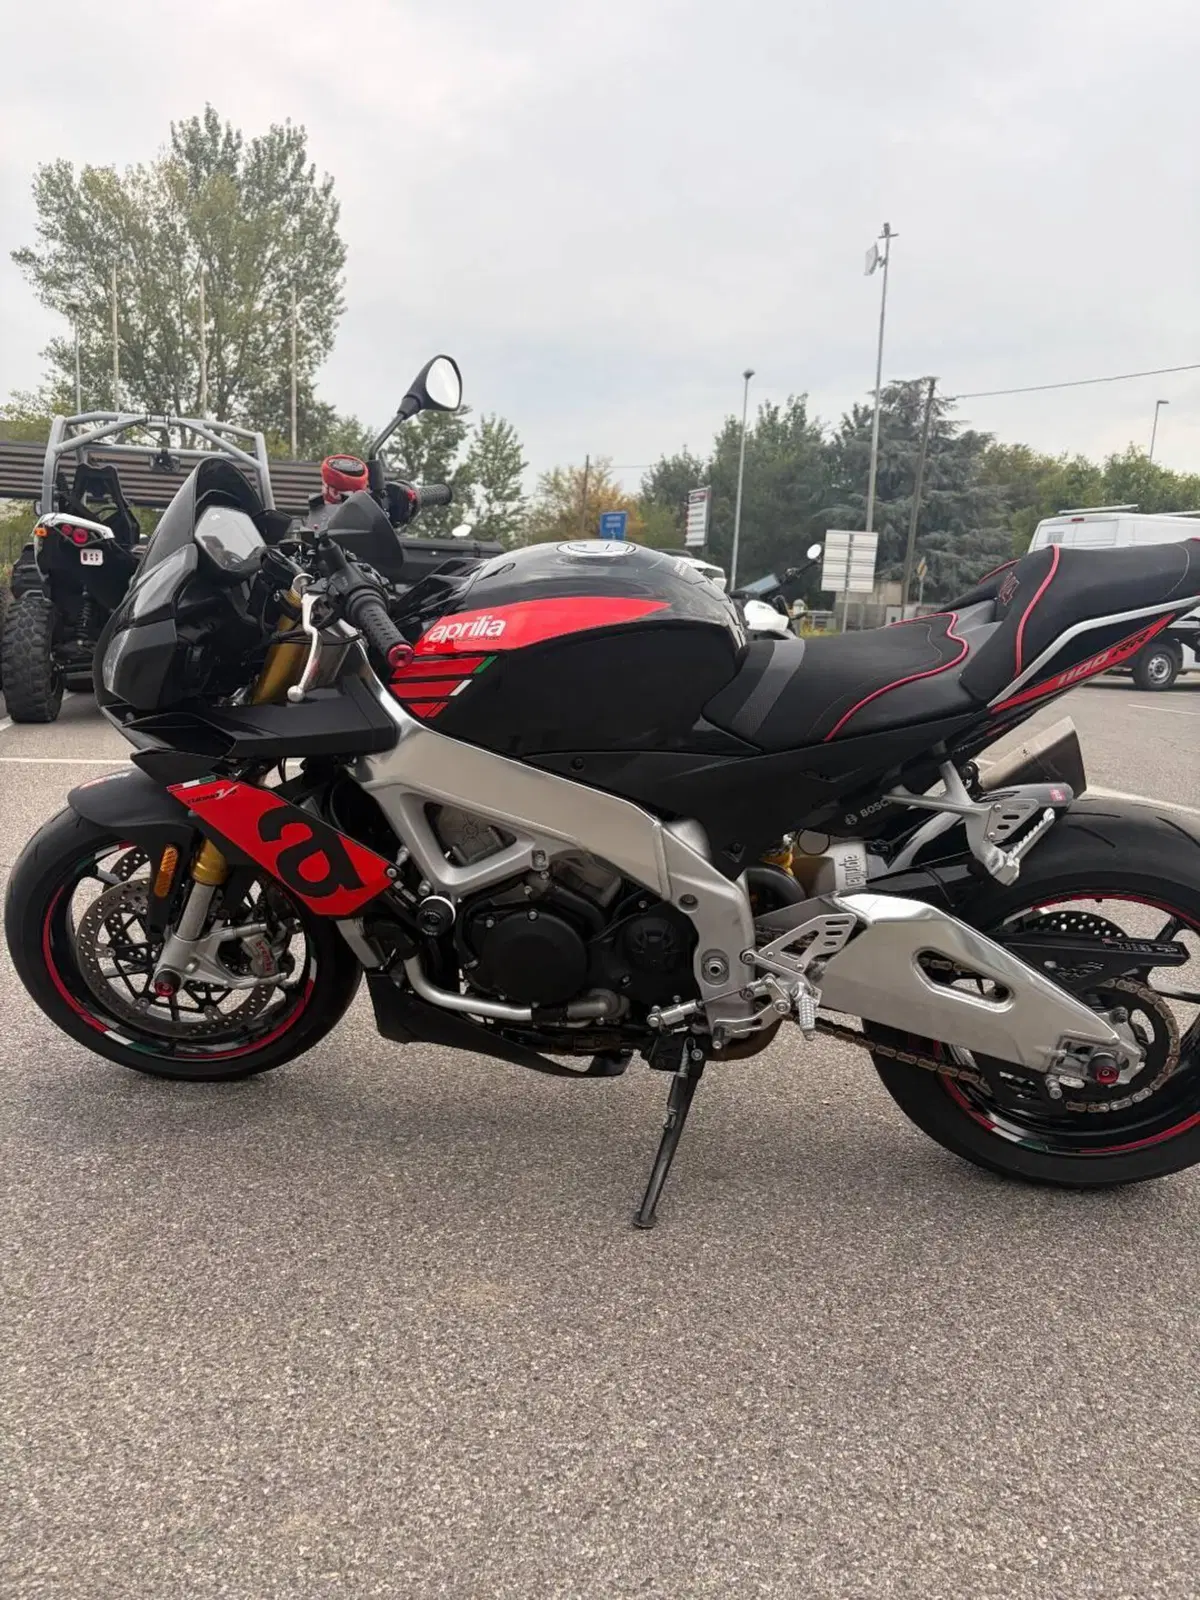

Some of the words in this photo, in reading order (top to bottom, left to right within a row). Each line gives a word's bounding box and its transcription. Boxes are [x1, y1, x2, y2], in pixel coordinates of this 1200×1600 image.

[428, 614, 507, 644] aprilia
[1057, 650, 1111, 689] 1100
[860, 798, 893, 818] BOSC
[257, 804, 367, 899] a
[838, 853, 869, 889] aprilia
